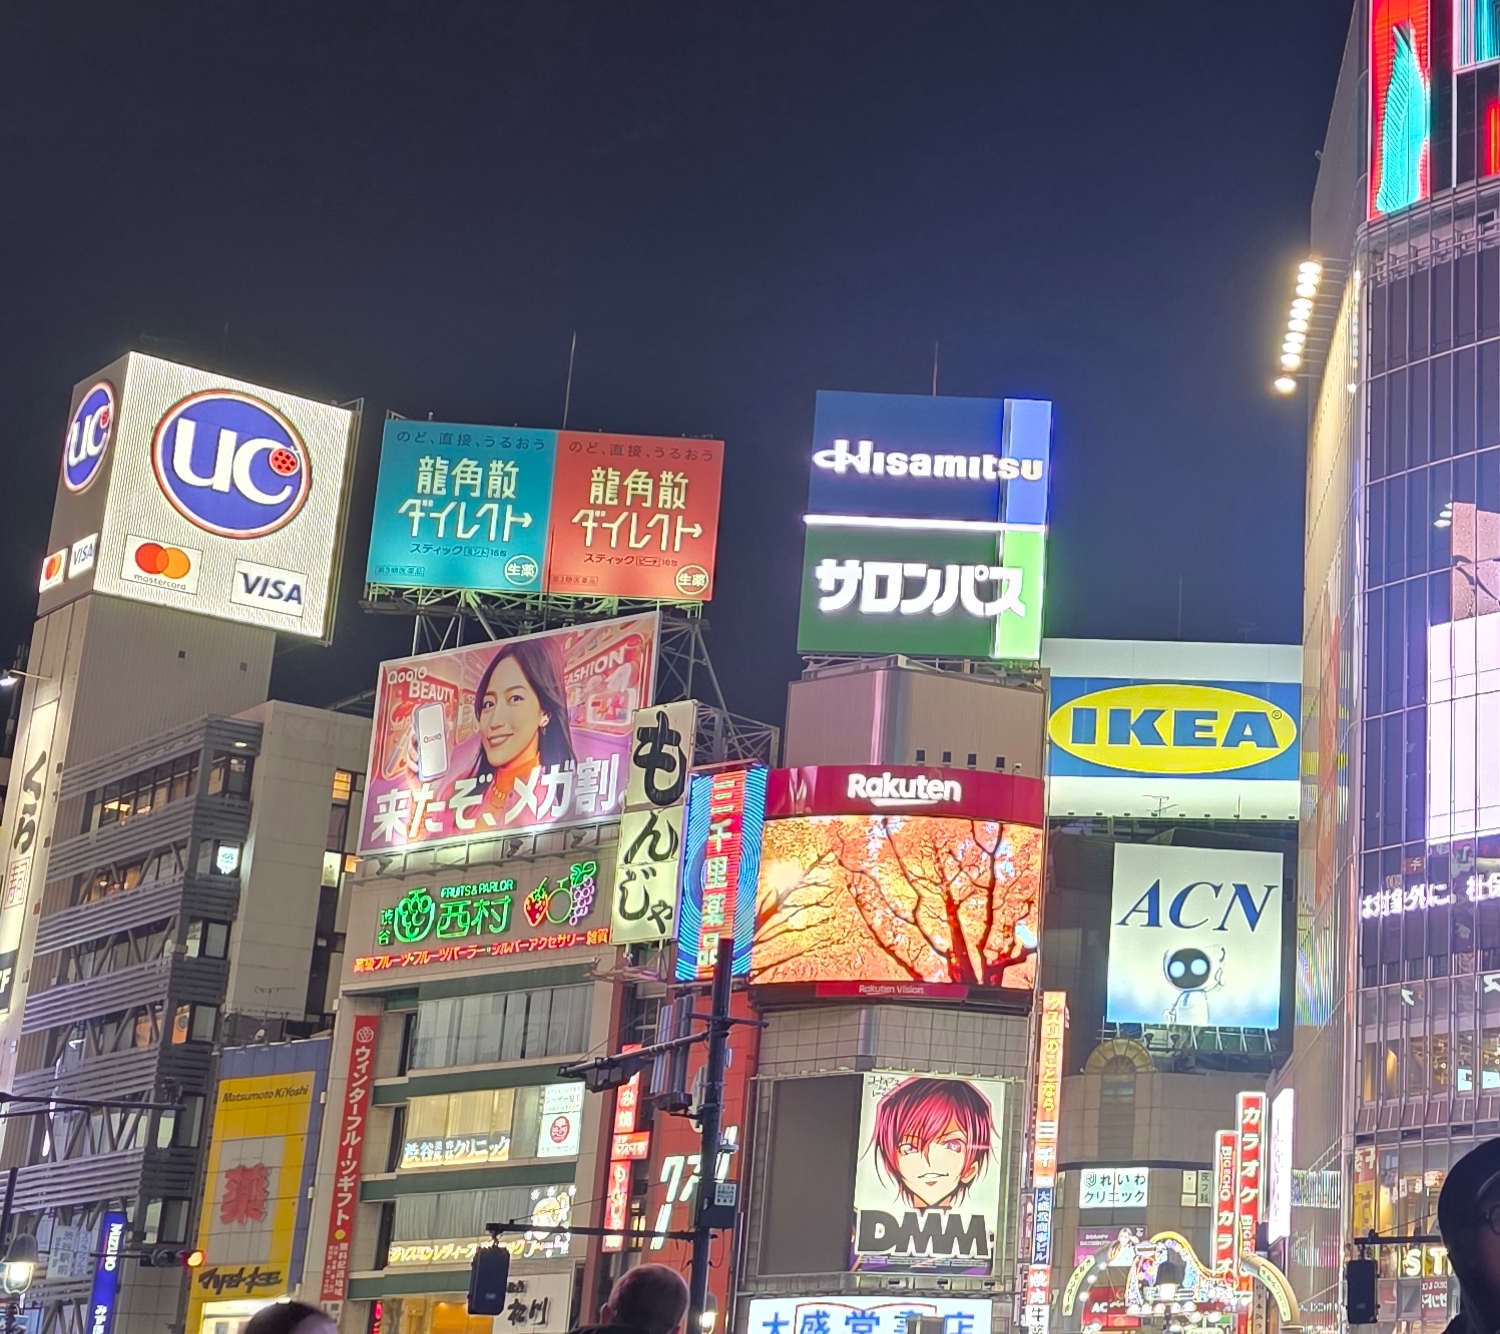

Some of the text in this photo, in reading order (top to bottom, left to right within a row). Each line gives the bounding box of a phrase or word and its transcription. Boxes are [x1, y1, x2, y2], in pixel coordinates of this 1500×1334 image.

[172, 417, 297, 506] UC
[396, 431, 546, 451] のど、直接、うるおう
[569, 441, 714, 462] のど、直接、うるおう
[812, 437, 1044, 482] Hisamitsu
[416, 455, 520, 499] 龍角散
[589, 466, 689, 510] 龍角散
[398, 498, 533, 542] ダイレクト
[571, 509, 703, 552] ダイレクト
[73, 542, 94, 566] VISA
[133, 572, 187, 591] mastercard
[237, 570, 303, 605] VISA
[815, 557, 1027, 618] サロンパス
[1069, 708, 1282, 749] IKEA
[847, 772, 962, 805] Rakuten
[618, 710, 687, 935] もんじゃ
[436, 895, 511, 938] 西村
[1118, 878, 1281, 933] ACN
[1042, 995, 1063, 1112] クスリのことなら
[222, 1090, 275, 1103] Matsumoto
[336, 1045, 371, 1226] ウィンターフルーツギフト
[1240, 1106, 1261, 1204] カラオケ
[1083, 1190, 1145, 1204] クリニック
[1099, 1173, 1146, 1186] れいわ
[857, 1209, 989, 1256] DMM
